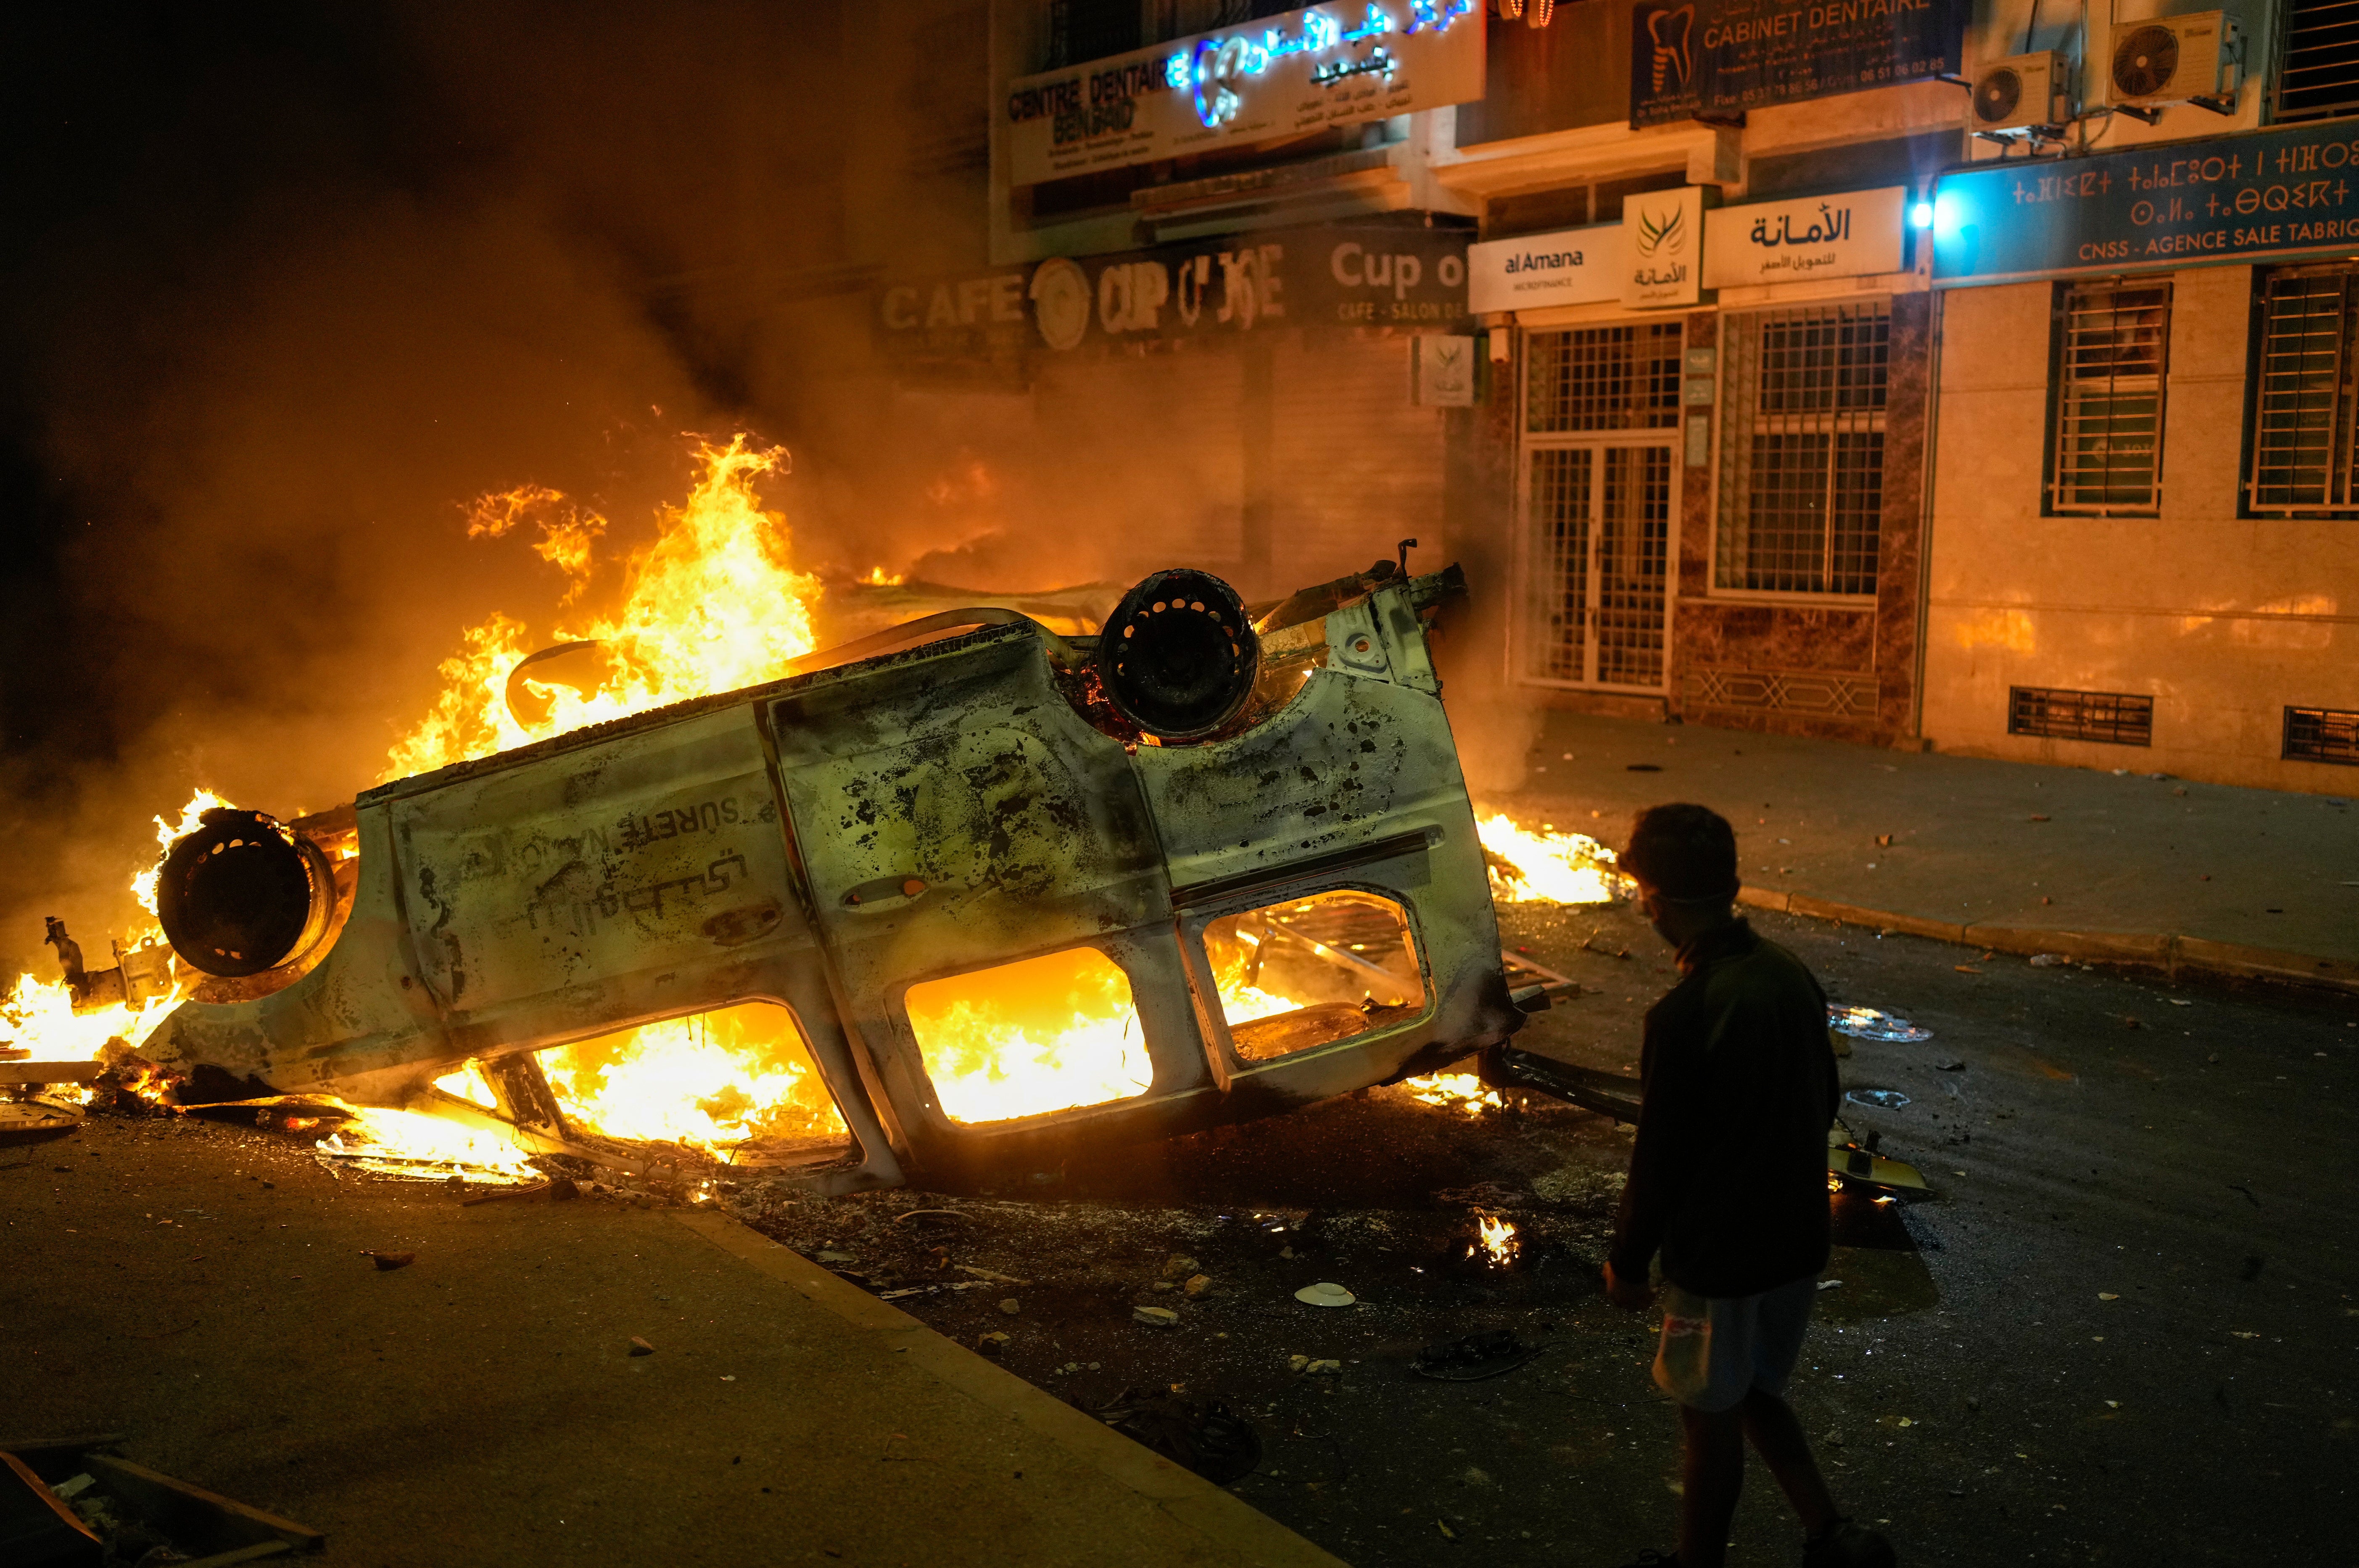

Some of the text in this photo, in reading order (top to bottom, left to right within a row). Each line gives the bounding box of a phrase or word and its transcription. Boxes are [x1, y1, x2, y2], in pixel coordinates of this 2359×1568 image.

[1704, 11, 1802, 49] CABINET
[1810, 0, 1930, 29] DENTAIRE
[1008, 79, 1080, 121] CENTRE
[1750, 202, 1850, 247] الأمانة
[2079, 240, 2129, 260] CNSS
[2145, 230, 2227, 255] AGENCE
[2234, 225, 2281, 246] SALE
[2288, 218, 2359, 242] TABRIQ
[1330, 242, 1422, 300] Cup
[1391, 302, 1440, 320] SALON
